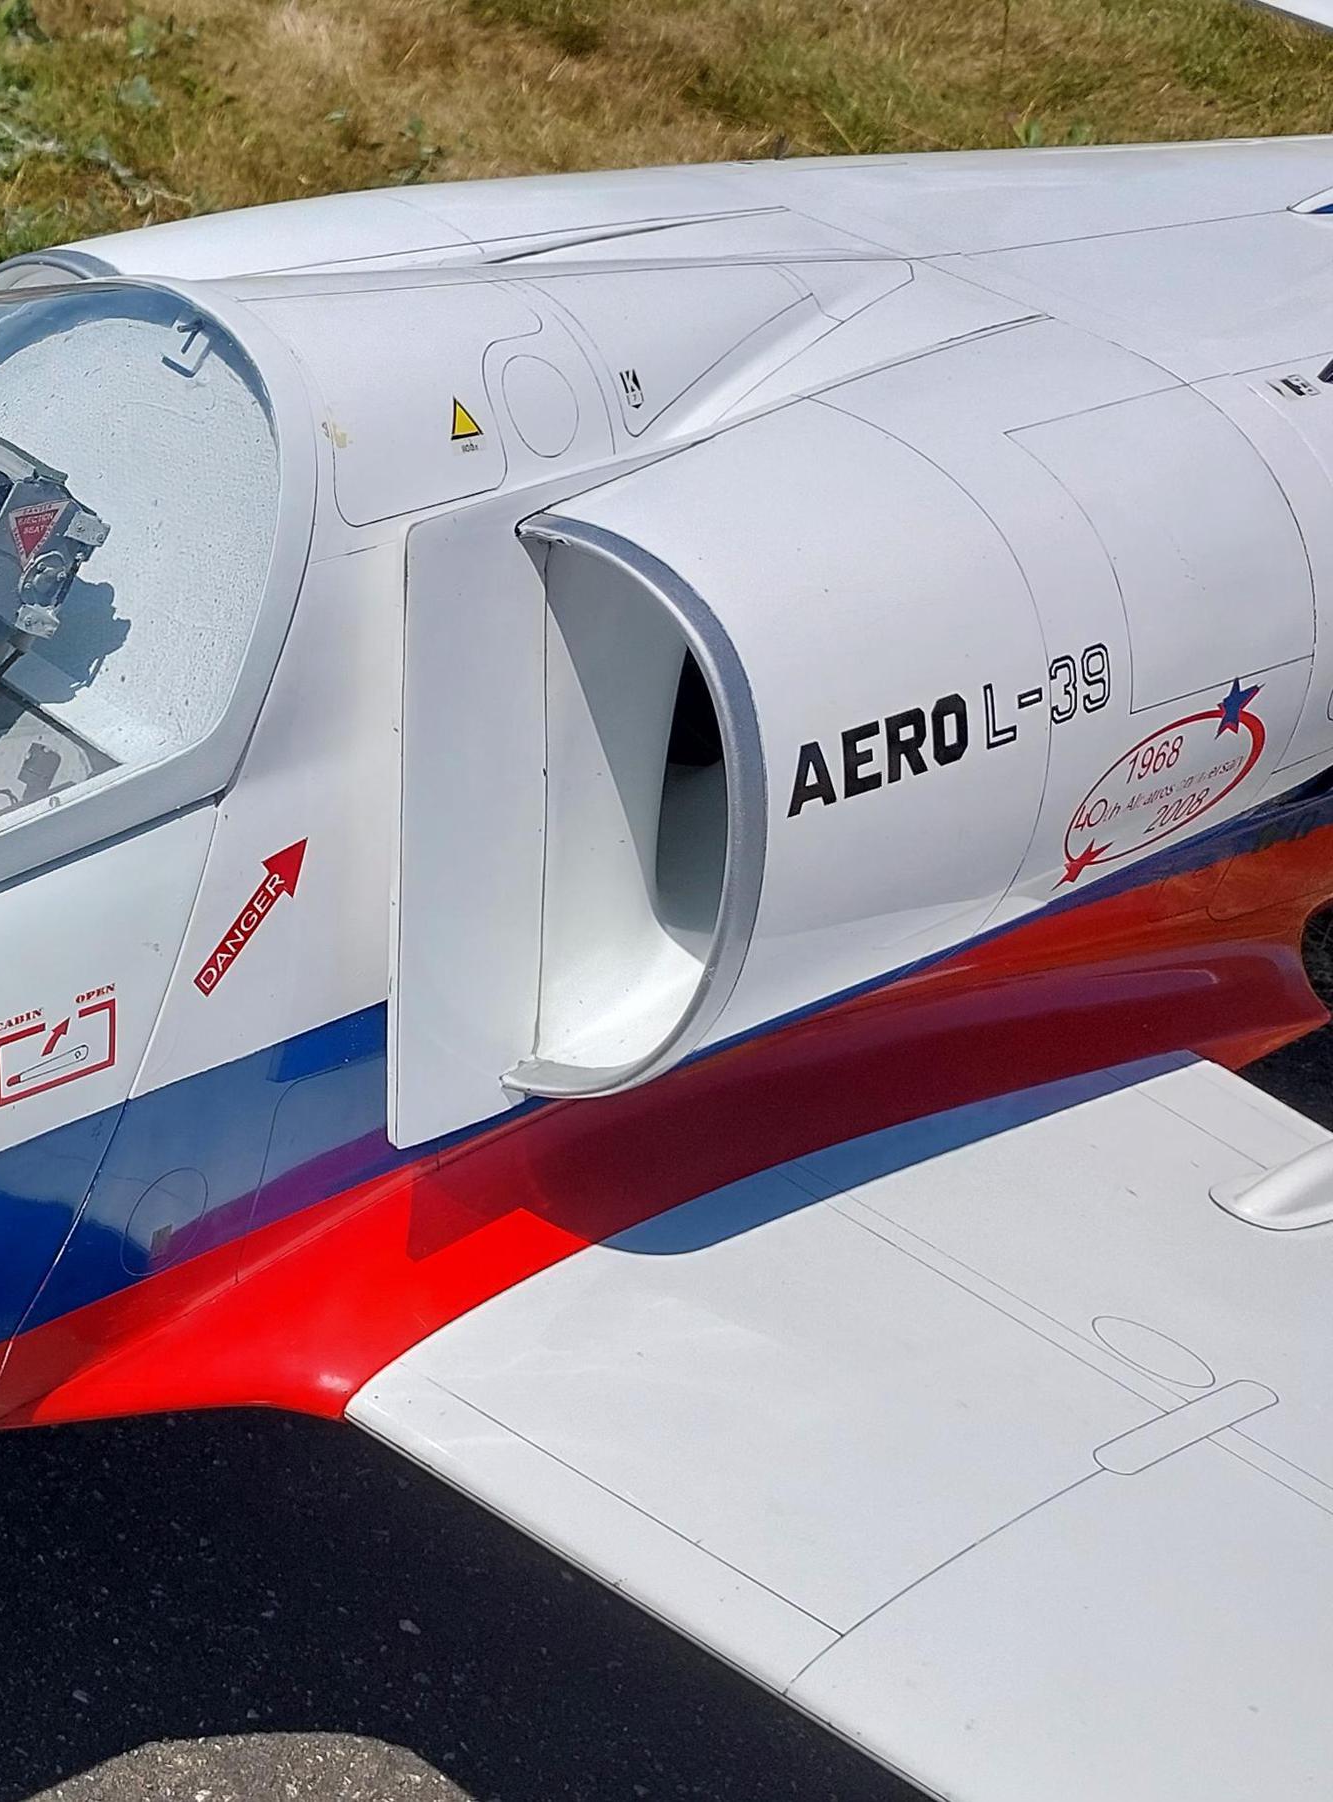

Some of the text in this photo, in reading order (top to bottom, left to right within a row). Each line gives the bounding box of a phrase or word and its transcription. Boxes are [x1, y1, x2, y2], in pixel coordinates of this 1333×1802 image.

[787, 642, 1111, 819] AERO L-39
[1126, 735, 1184, 785] 1968
[1143, 787, 1210, 834] 2008
[198, 872, 286, 990] DANGER
[75, 982, 117, 1005] OPEN
